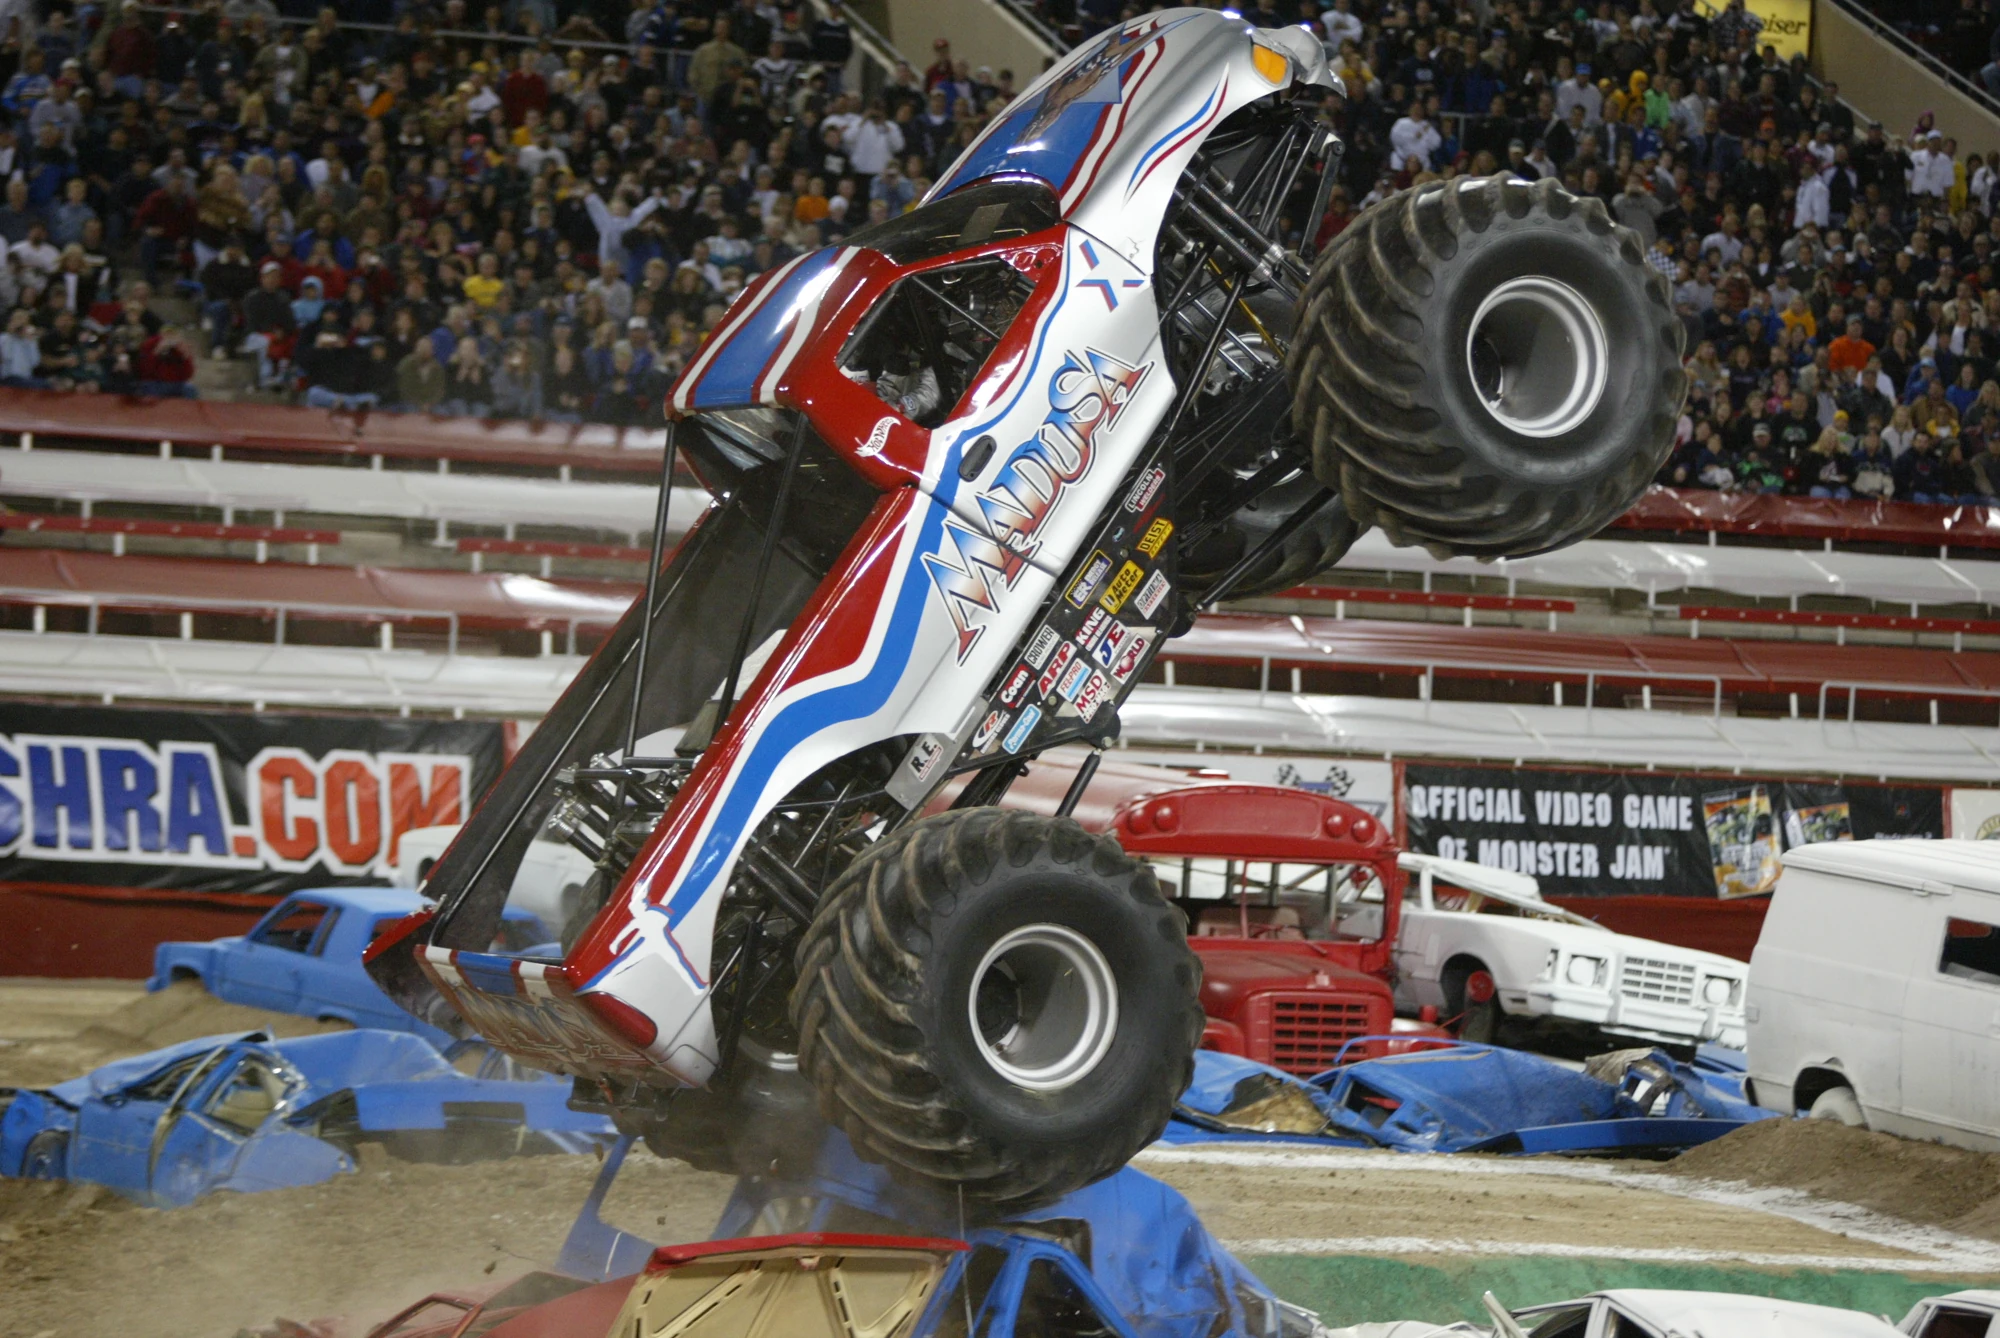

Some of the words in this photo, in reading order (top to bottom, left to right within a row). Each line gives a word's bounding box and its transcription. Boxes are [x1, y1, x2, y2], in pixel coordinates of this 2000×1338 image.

[921, 346, 1154, 667] MADUSA
[1128, 473, 1154, 508] LINCOLN
[1140, 520, 1166, 551] DEIST
[1112, 568, 1132, 592] Auto
[1115, 569, 1140, 604] Meter
[1027, 626, 1054, 665] CROWER
[1075, 607, 1105, 645] KING
[1101, 623, 1125, 666] JE
[1039, 642, 1071, 695] ARP
[1114, 637, 1145, 679] WORLD
[1001, 670, 1029, 703] Coan
[1075, 674, 1102, 713] MSD
[1410, 785, 1525, 823] OFFICIAL
[1535, 790, 1612, 827] VIDEO
[1623, 794, 1693, 831] GAME
[1438, 835, 1468, 861] OF
[1478, 838, 1600, 878] MONSTER
